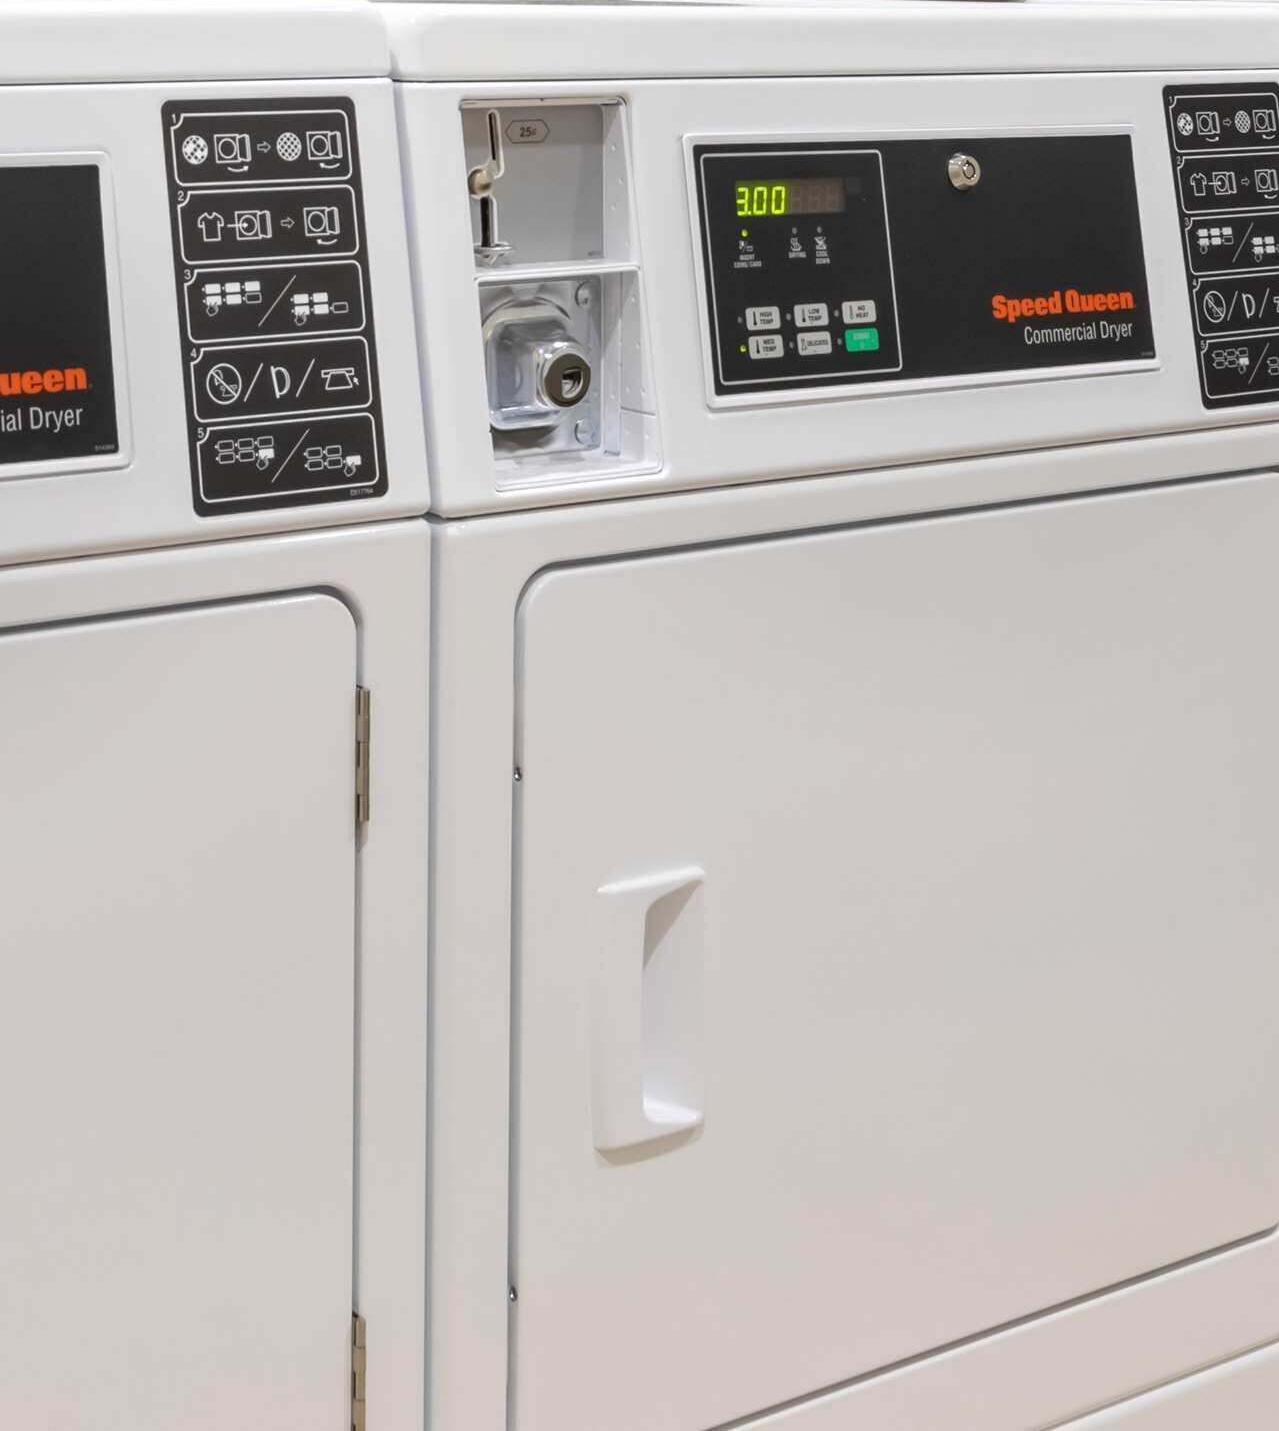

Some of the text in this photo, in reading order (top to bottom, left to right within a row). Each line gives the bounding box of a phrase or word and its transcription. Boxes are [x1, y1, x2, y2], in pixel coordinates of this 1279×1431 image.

[177, 191, 185, 202] 2
[736, 186, 786, 216] 3.00
[184, 269, 192, 280] 3
[992, 289, 1134, 323] Speed Queen
[1024, 320, 1134, 345] Commercial Dryer
[190, 348, 198, 358] 4
[29, 407, 84, 433] Dryer
[197, 427, 205, 438] 5
